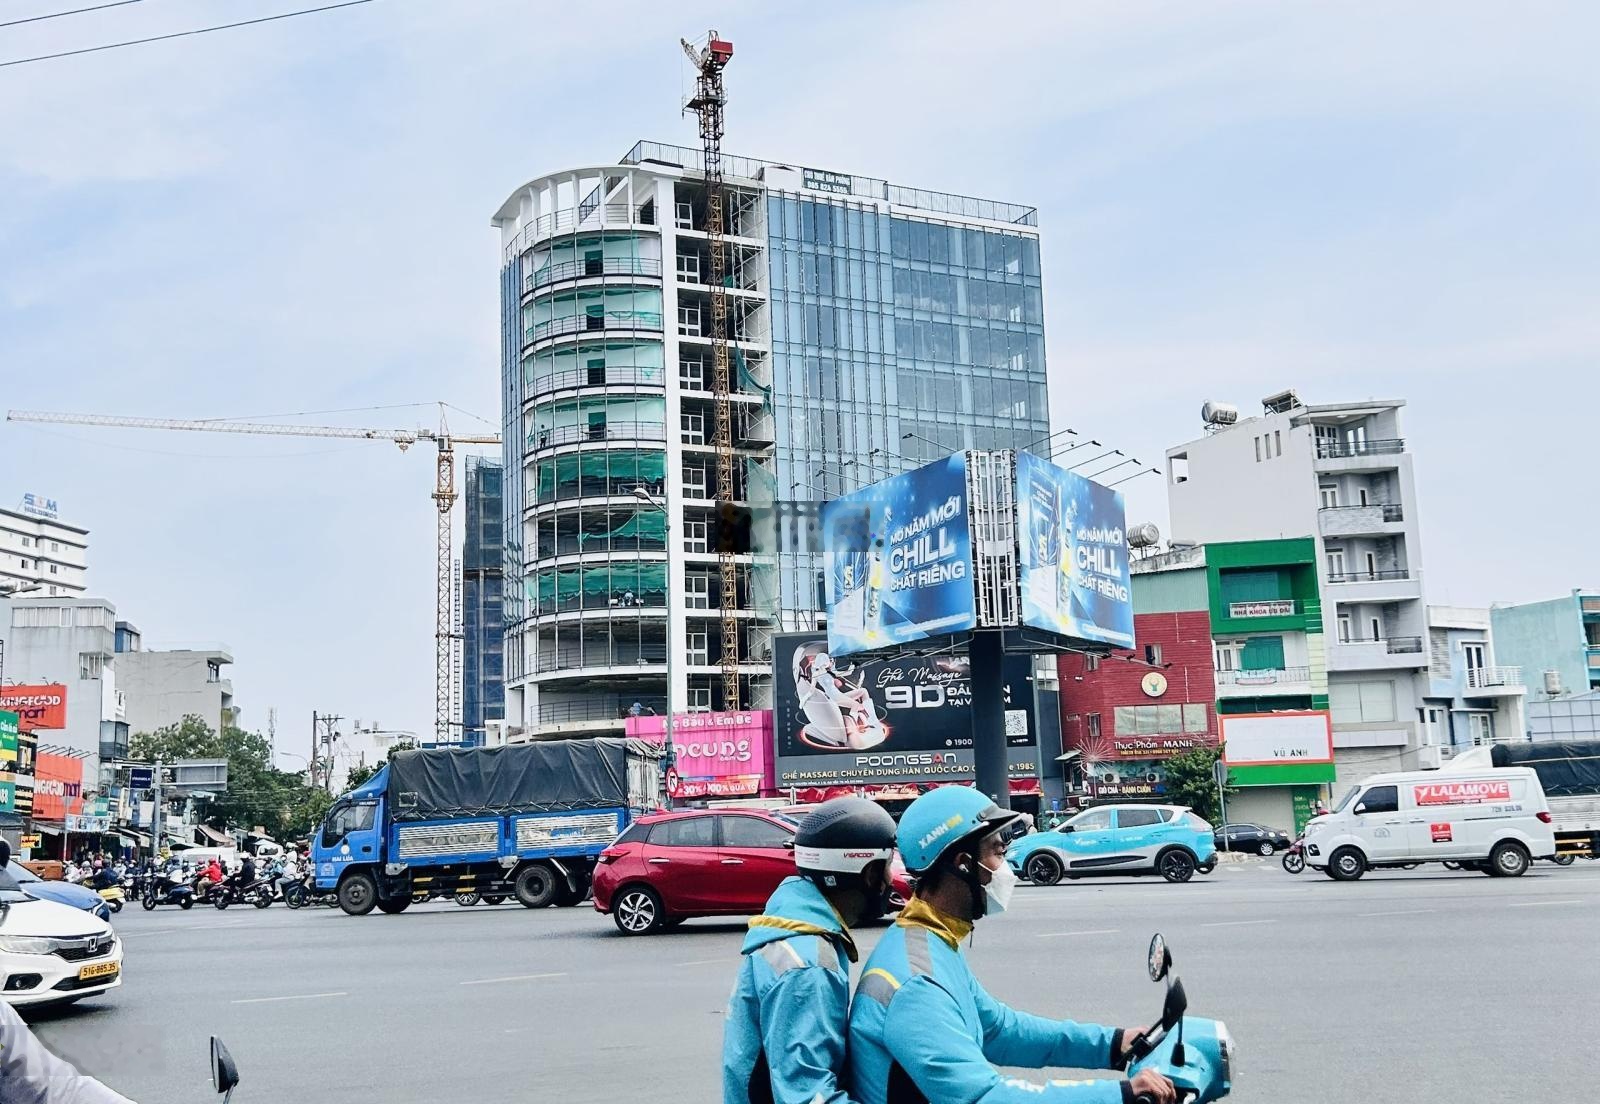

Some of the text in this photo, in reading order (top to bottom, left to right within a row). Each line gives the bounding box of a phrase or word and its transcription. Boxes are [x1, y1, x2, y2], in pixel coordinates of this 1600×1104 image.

[889, 526, 956, 574] CHILL
[1076, 545, 1121, 578] CHILL
[890, 560, 966, 593] CHẤT RIÊNG
[1097, 578, 1128, 603] RIÊNG
[877, 667, 961, 687] Ghế Massage
[0, 693, 61, 706] KINGFOOD
[884, 685, 945, 709] 9D
[716, 717, 735, 726] Em
[736, 714, 752, 724] Bé
[954, 738, 973, 746] 1900
[856, 753, 957, 767] POONGSAN
[1290, 749, 1308, 757] ANH
[799, 770, 838, 779] MASSAGE
[840, 767, 874, 778] CHUYÊN
[951, 765, 970, 773] CAO
[1016, 762, 1035, 771] 1985
[1430, 783, 1508, 797] LALAMOVE
[918, 822, 949, 849] XANH
